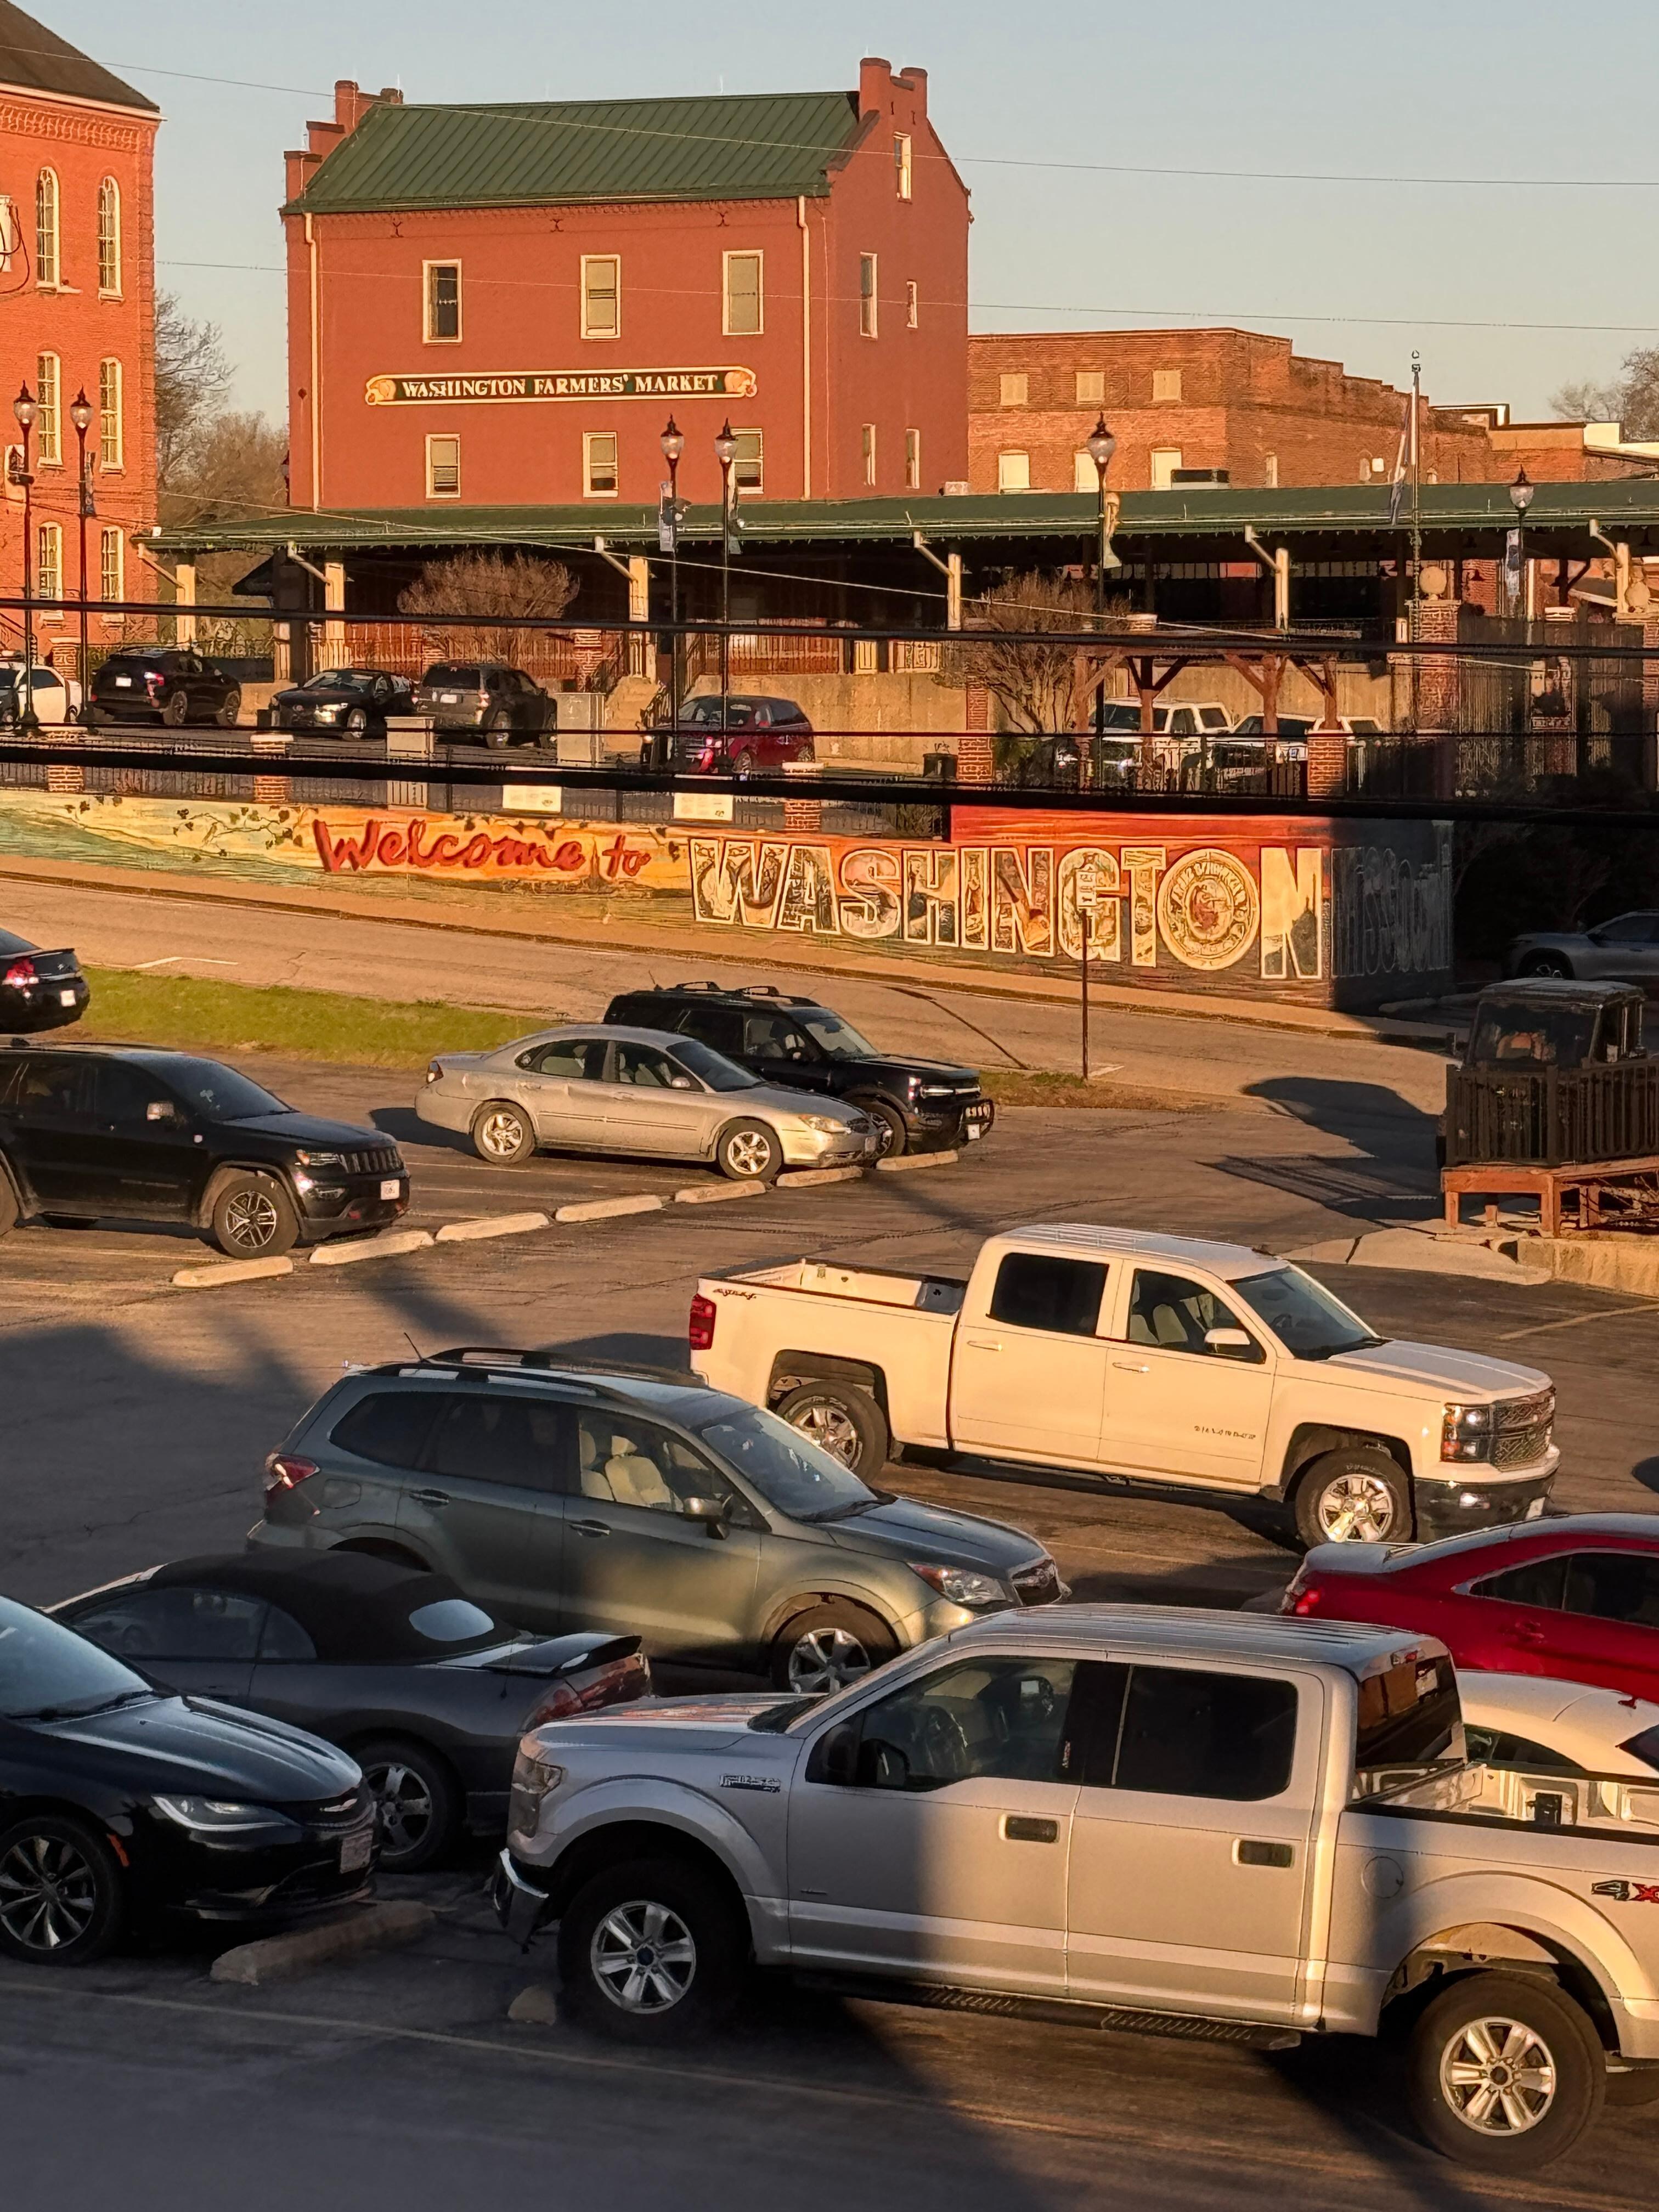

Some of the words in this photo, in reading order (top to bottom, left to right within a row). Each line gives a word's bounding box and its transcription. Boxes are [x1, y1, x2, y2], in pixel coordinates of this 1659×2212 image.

[402, 379, 526, 398] WASHINGTON
[534, 374, 629, 394] FARMERS'
[635, 374, 718, 393] MARKET
[313, 819, 586, 872] Welcome
[602, 834, 652, 877] to
[690, 838, 1322, 980] WASHINGTON
